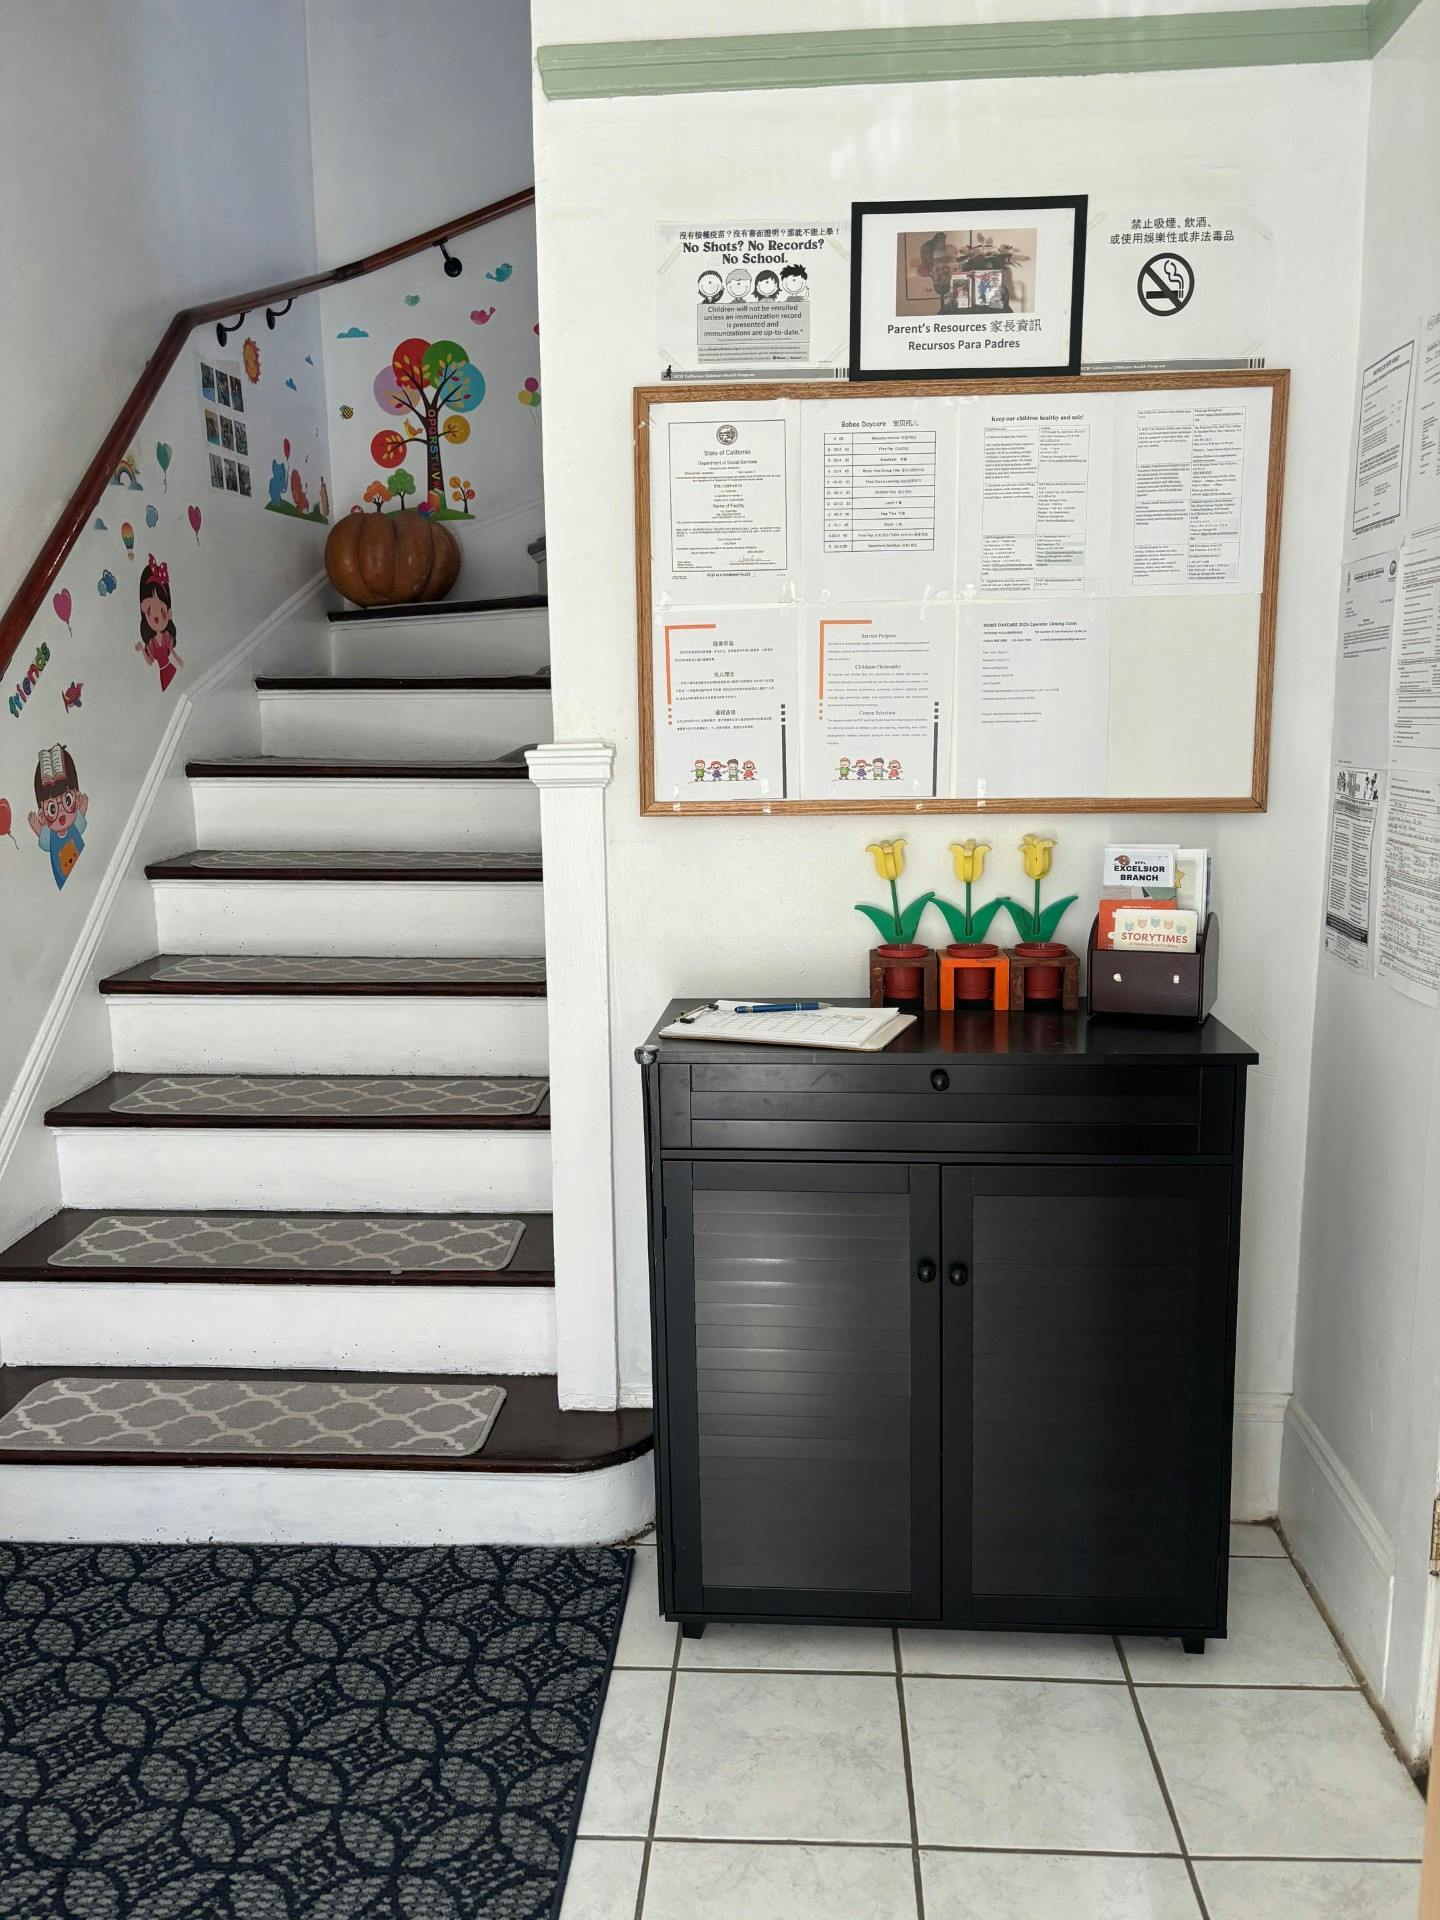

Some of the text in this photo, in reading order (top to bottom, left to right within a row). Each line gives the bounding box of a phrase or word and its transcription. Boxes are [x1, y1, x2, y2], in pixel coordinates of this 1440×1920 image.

[683, 238, 825, 253] No Shots? No Records?
[722, 252, 788, 264] No School.
[732, 321, 766, 329] presented
[887, 322, 987, 334] Parent's Resources
[990, 319, 1042, 333] 家長資訊
[908, 338, 1021, 351] Recursos Para Padres
[9, 642, 50, 718] friends
[1113, 865, 1166, 873] EXCELSIOR
[1120, 874, 1159, 882] BRANCH
[1121, 932, 1188, 944] STORYTIMES
